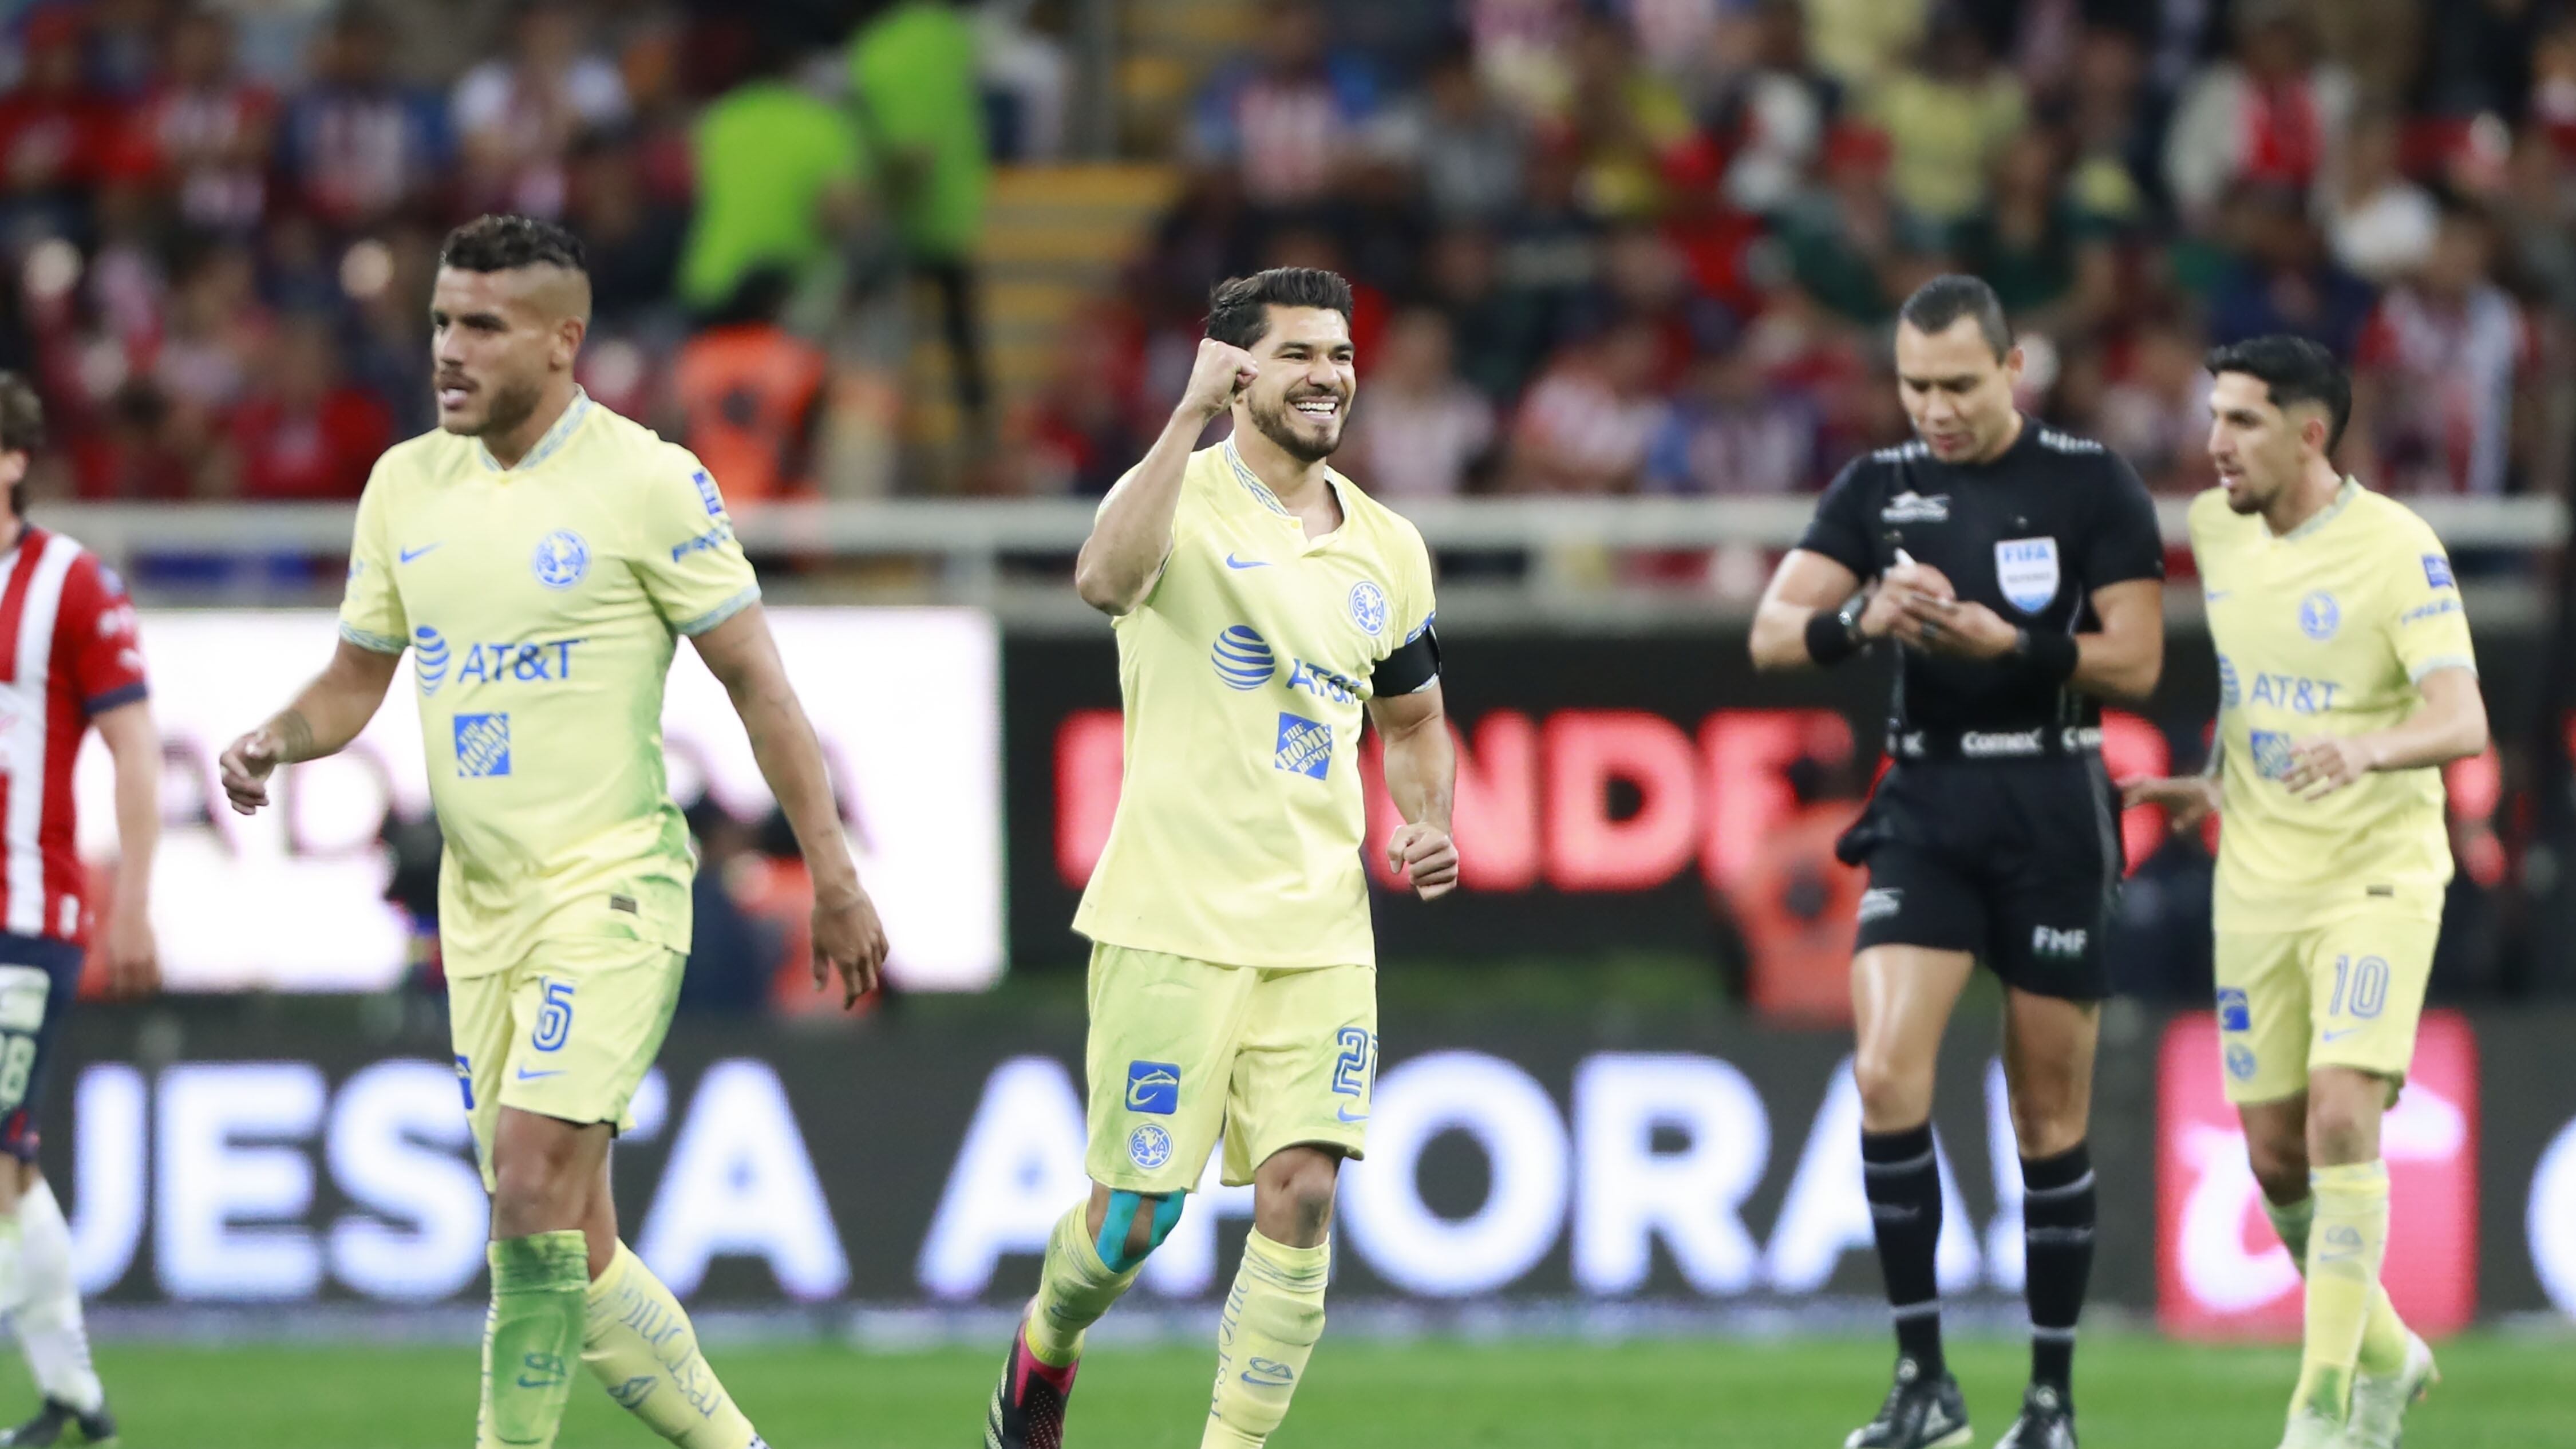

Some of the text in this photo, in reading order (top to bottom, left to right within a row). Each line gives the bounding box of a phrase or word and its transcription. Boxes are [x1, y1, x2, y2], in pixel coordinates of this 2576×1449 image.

[2004, 543, 2049, 562] FIFA
[457, 639, 580, 684] AT&T
[2250, 671, 2346, 715] AT&T
[1275, 724, 1333, 770] HOME
[1282, 722, 1307, 742] THE
[2033, 924, 2087, 953] FMF
[2329, 954, 2391, 1020] 10
[0, 1032, 37, 1108] 8
[68, 1057, 851, 1302] ESA
